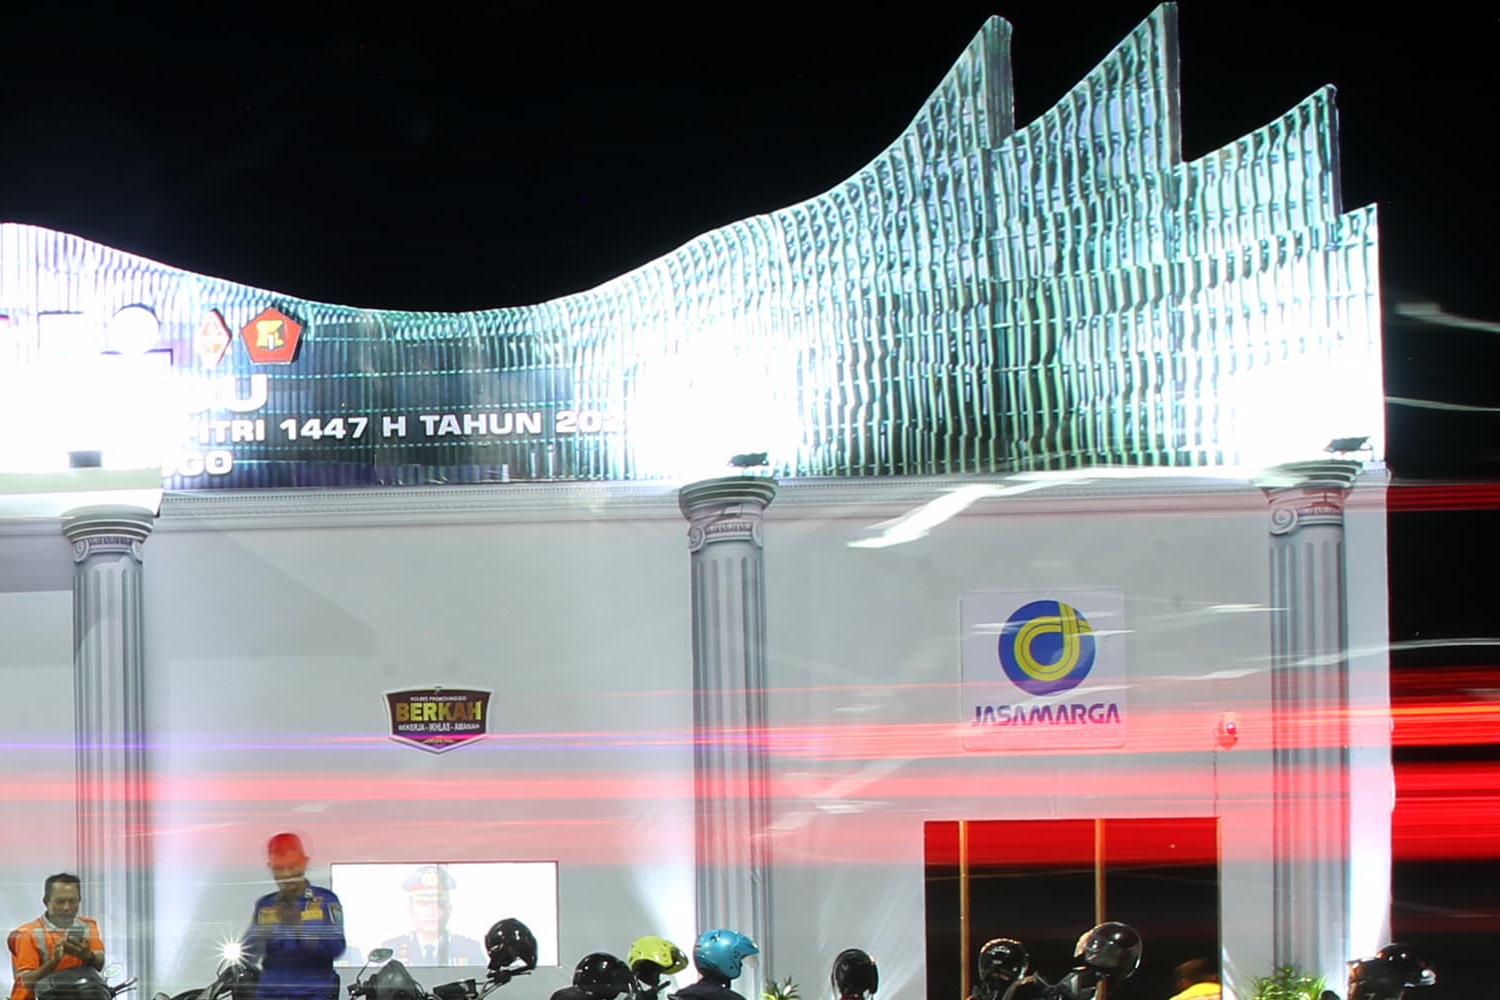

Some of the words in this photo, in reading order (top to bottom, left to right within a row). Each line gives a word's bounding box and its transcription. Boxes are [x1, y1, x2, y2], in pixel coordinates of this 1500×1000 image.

[184, 418, 265, 445] ITRI
[279, 416, 370, 441] 1447
[383, 415, 406, 437] H
[420, 411, 542, 436] TAHUN
[555, 409, 627, 433] 202
[395, 701, 482, 721] BERKAH
